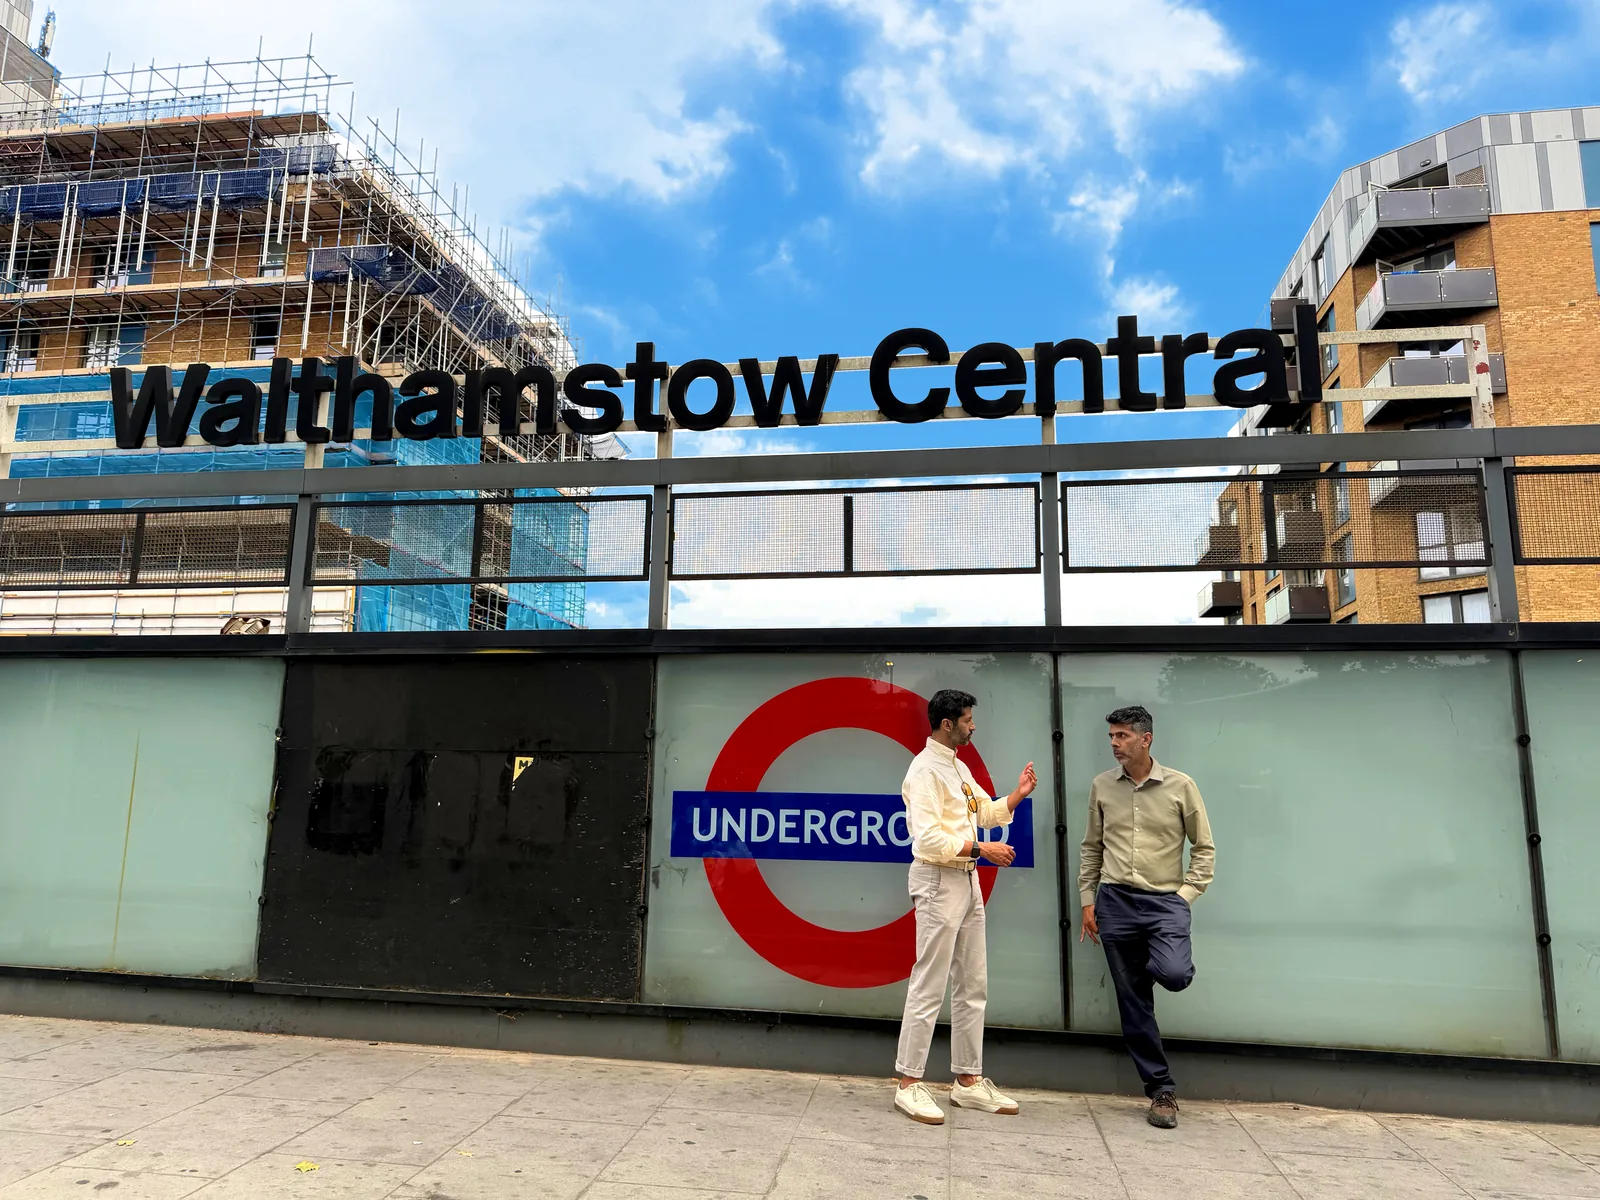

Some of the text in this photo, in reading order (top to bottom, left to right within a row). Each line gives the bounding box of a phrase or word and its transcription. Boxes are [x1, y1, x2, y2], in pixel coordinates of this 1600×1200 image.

[110, 304, 1323, 449] Walthamstow Central
[692, 807, 1010, 848] UNDERGRO
